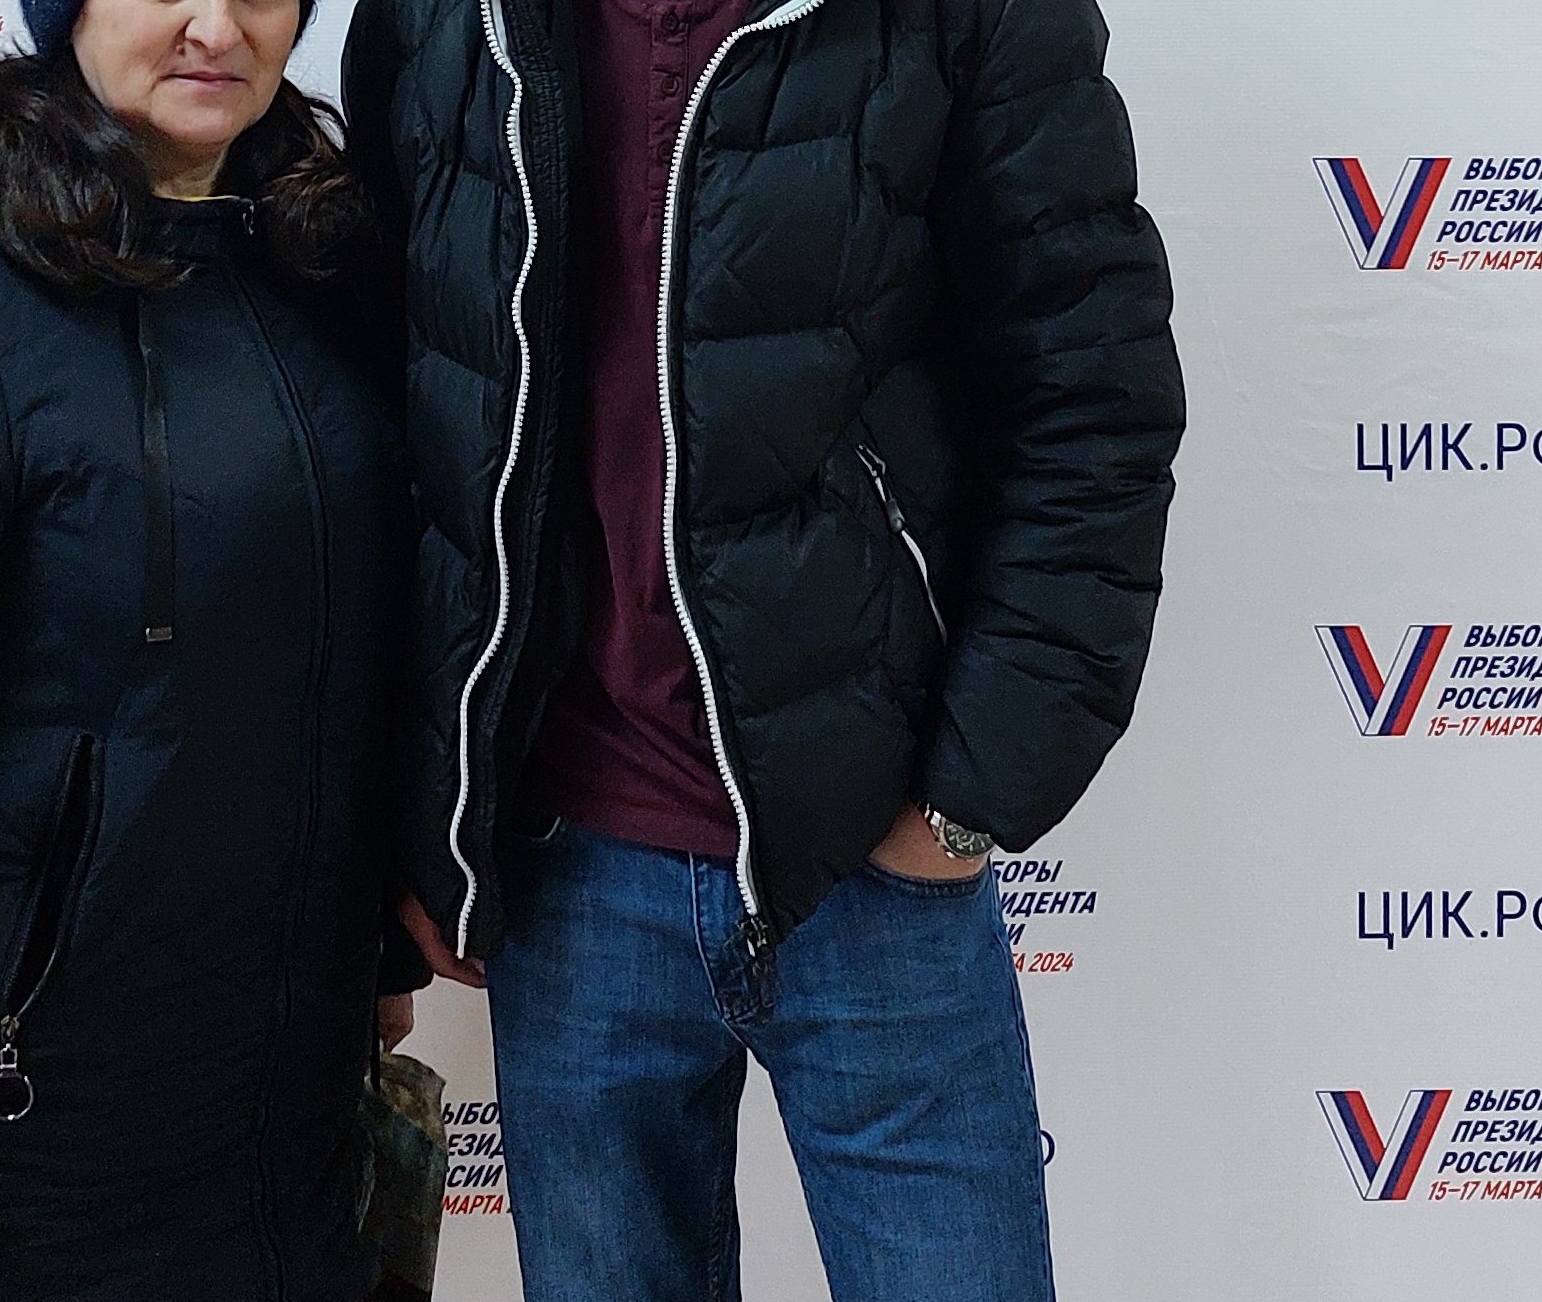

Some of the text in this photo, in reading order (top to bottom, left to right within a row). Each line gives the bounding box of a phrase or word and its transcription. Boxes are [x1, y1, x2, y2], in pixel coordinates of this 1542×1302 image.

[991, 859, 1064, 883] БОРЫ
[1000, 891, 1098, 918] ИДЕНТА
[1027, 952, 1075, 973] 2024
[446, 1164, 504, 1188] СИИ
[442, 1194, 505, 1215] МАРТА
